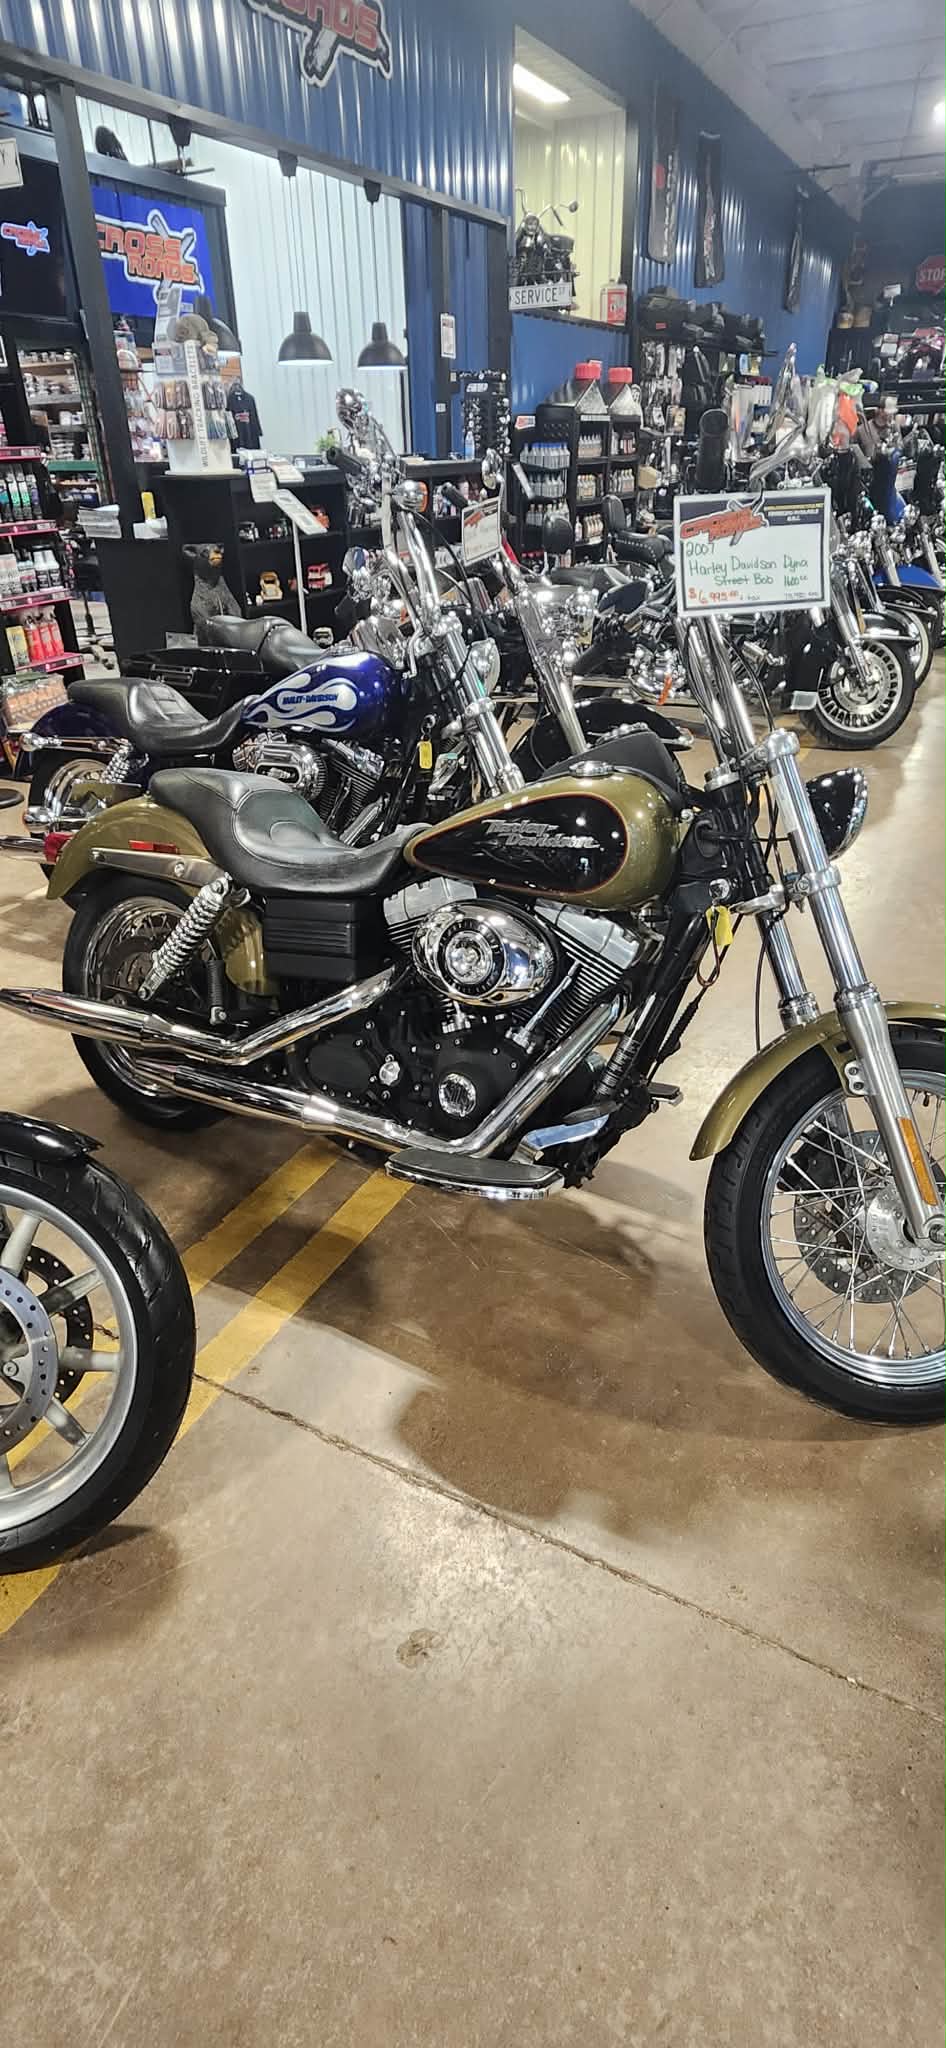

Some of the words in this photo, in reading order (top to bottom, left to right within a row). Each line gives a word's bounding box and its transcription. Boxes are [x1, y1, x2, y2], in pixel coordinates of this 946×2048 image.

[280, 0, 379, 51] ADS
[514, 287, 558, 305] SERVICE
[685, 542, 715, 556] 2007
[689, 559, 728, 578] Harley
[731, 555, 777, 570] Davidson
[783, 554, 808, 573] Dyna
[714, 575, 750, 587] Street
[753, 574, 774, 585] Bob
